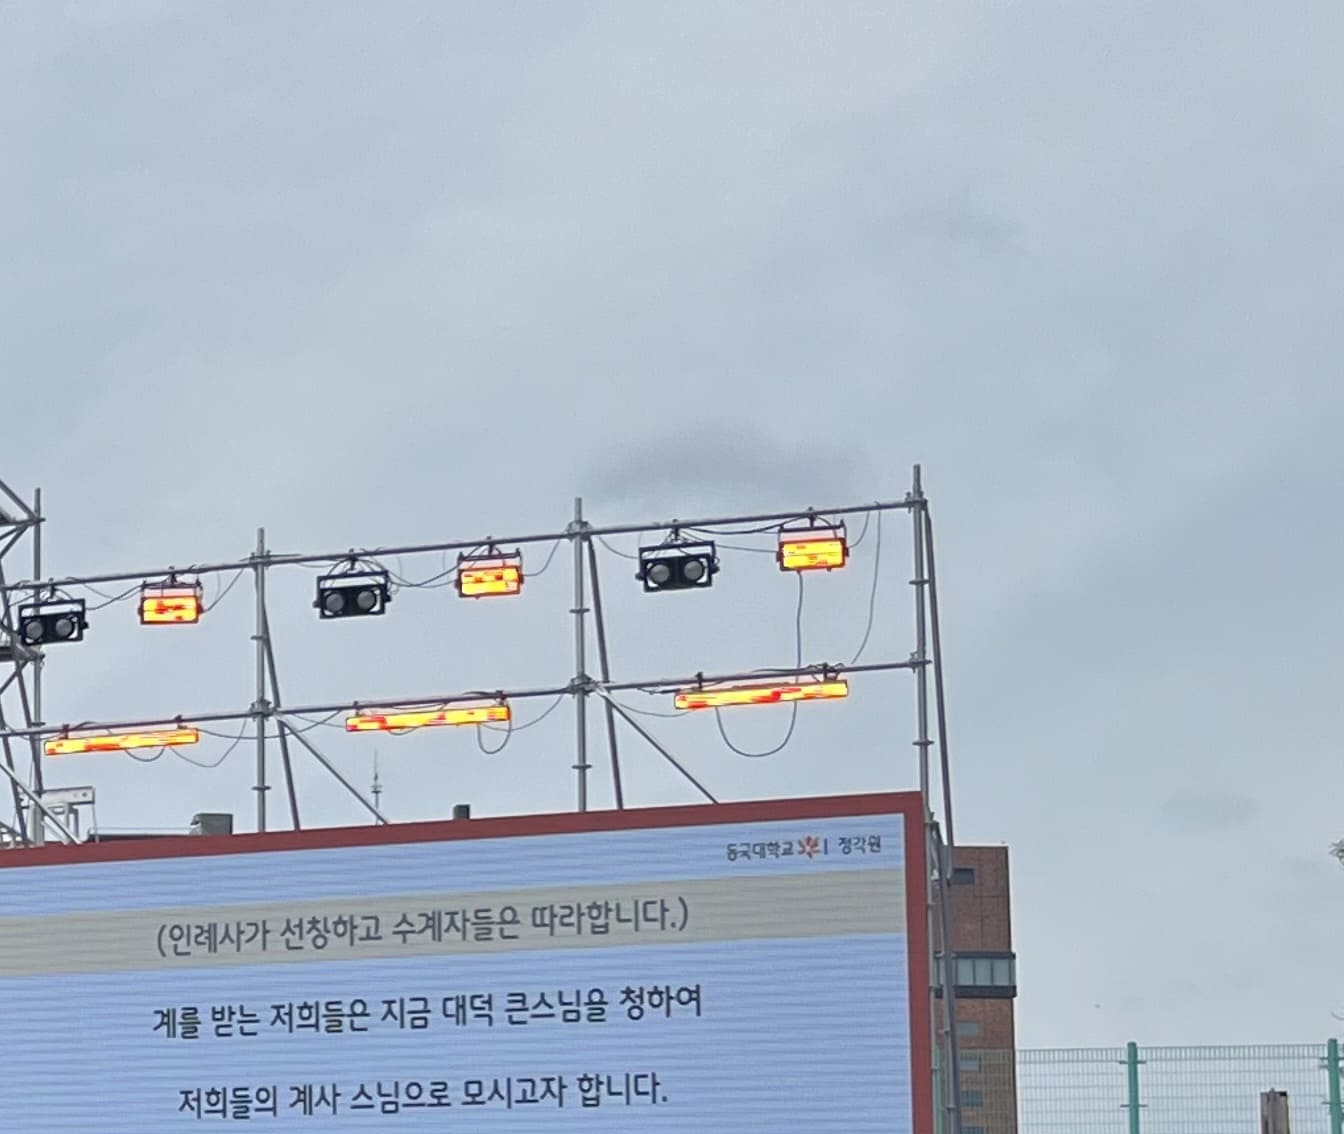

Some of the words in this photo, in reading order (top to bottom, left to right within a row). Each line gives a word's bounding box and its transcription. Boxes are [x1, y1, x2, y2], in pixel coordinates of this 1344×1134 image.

[727, 842, 794, 862] 동국대학교
[838, 835, 882, 855] 정각원
[157, 919, 271, 957] (인례사가
[279, 914, 383, 950] 선창하고
[391, 905, 521, 944] 수계자들은
[531, 896, 689, 937] 따라합니다.)
[153, 1006, 201, 1039] 계를
[211, 1004, 261, 1038] 받는
[269, 998, 371, 1034] 저희들은
[380, 996, 432, 1030] 지금
[442, 993, 494, 1027] 대덕
[503, 987, 609, 1026] 큰스님을
[619, 983, 702, 1021] 청하여
[178, 1084, 278, 1120] 저희들의
[289, 1082, 342, 1116] 계사
[349, 1080, 452, 1115] 스님으로
[460, 1075, 569, 1110] 모시고자
[576, 1071, 668, 1108] 합니다.
